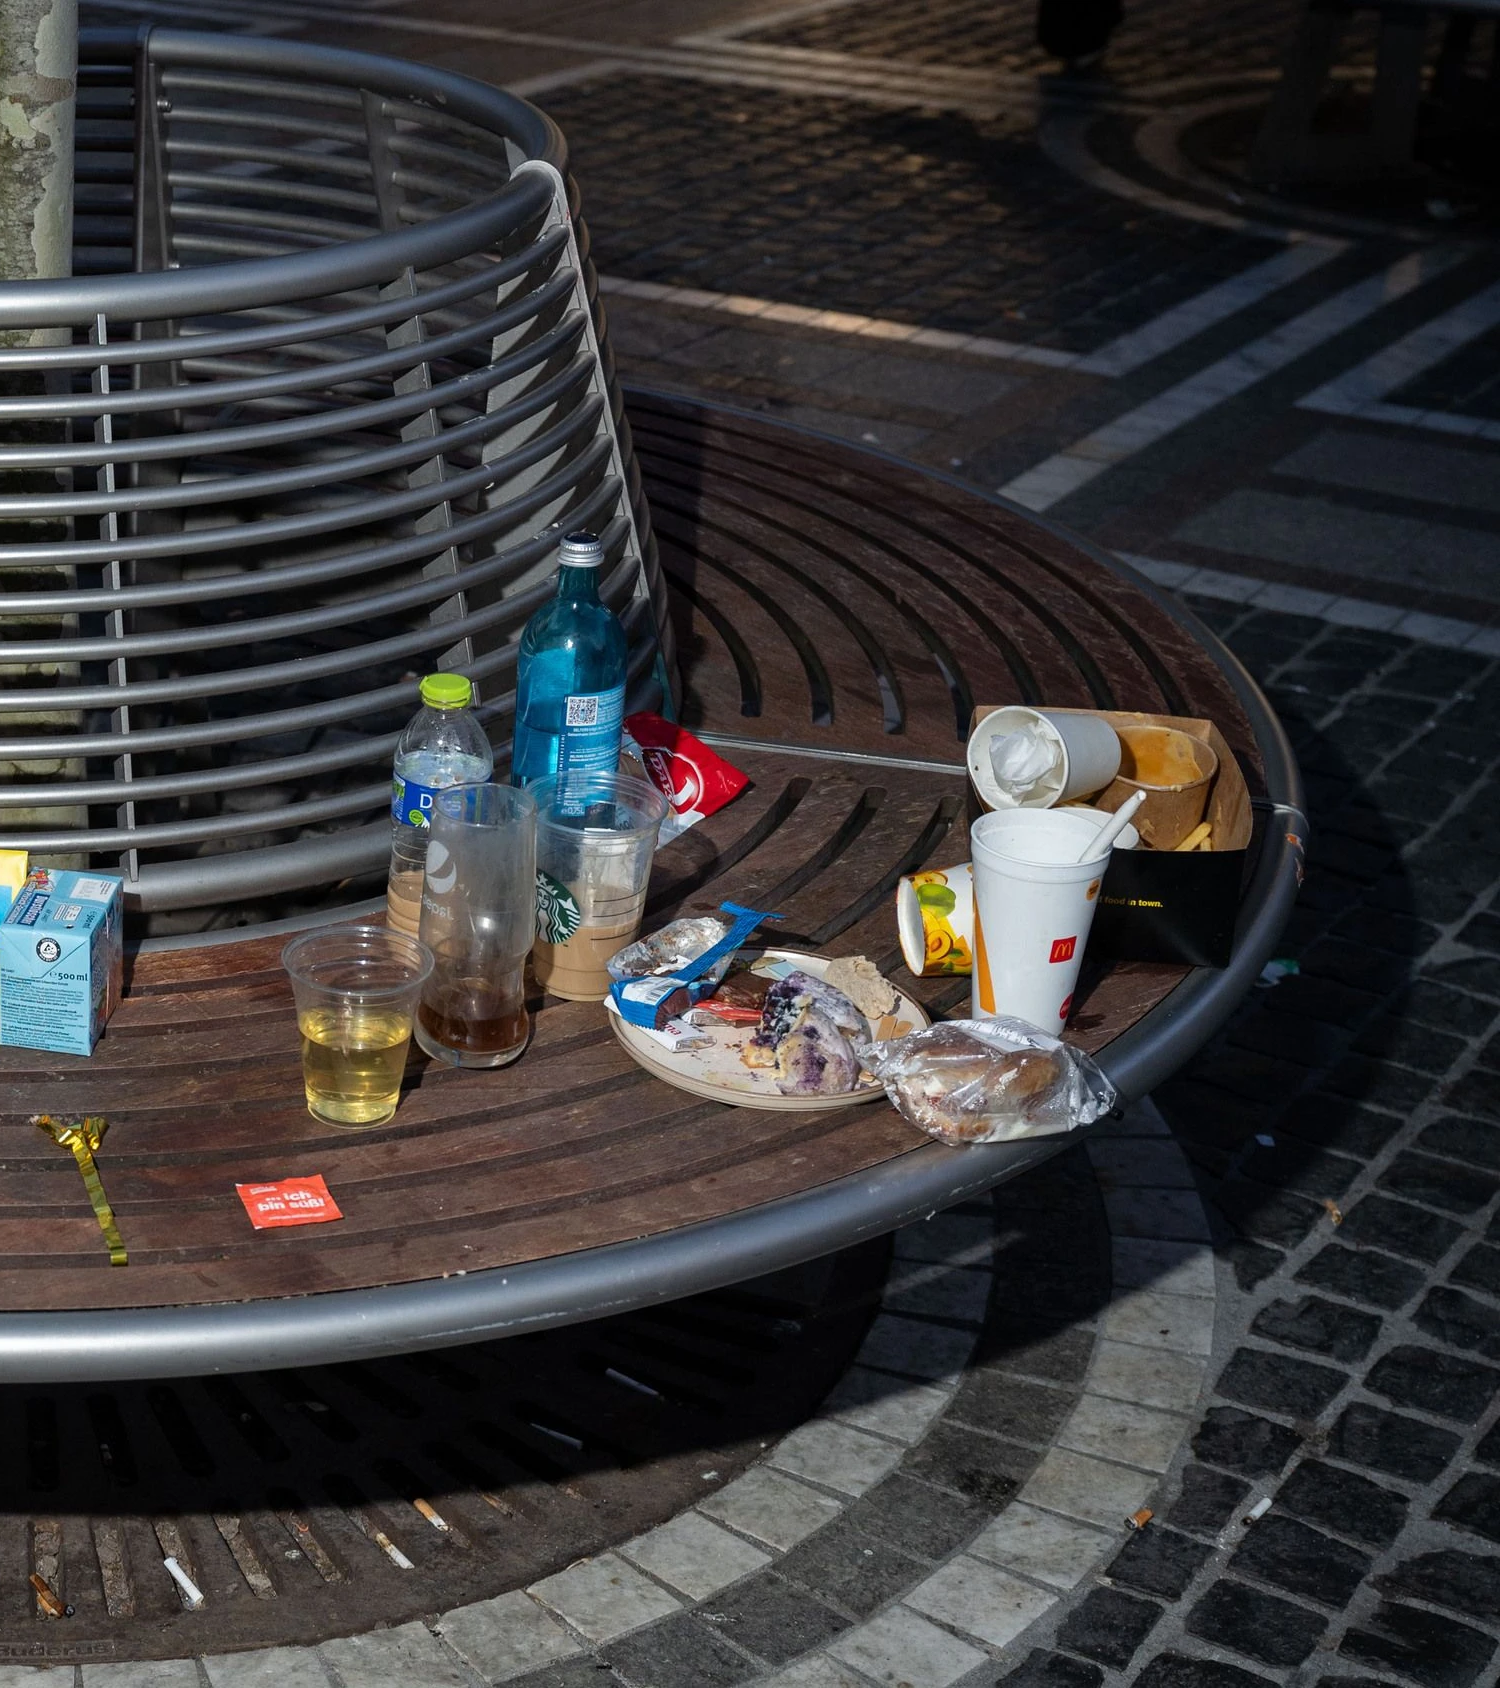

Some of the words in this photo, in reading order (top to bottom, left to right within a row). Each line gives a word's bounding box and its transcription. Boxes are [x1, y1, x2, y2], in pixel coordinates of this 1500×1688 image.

[1104, 896, 1126, 906] food
[1127, 898, 1137, 907] in
[1138, 899, 1164, 908] town.
[57, 973, 75, 981] 500
[76, 973, 88, 982] ml
